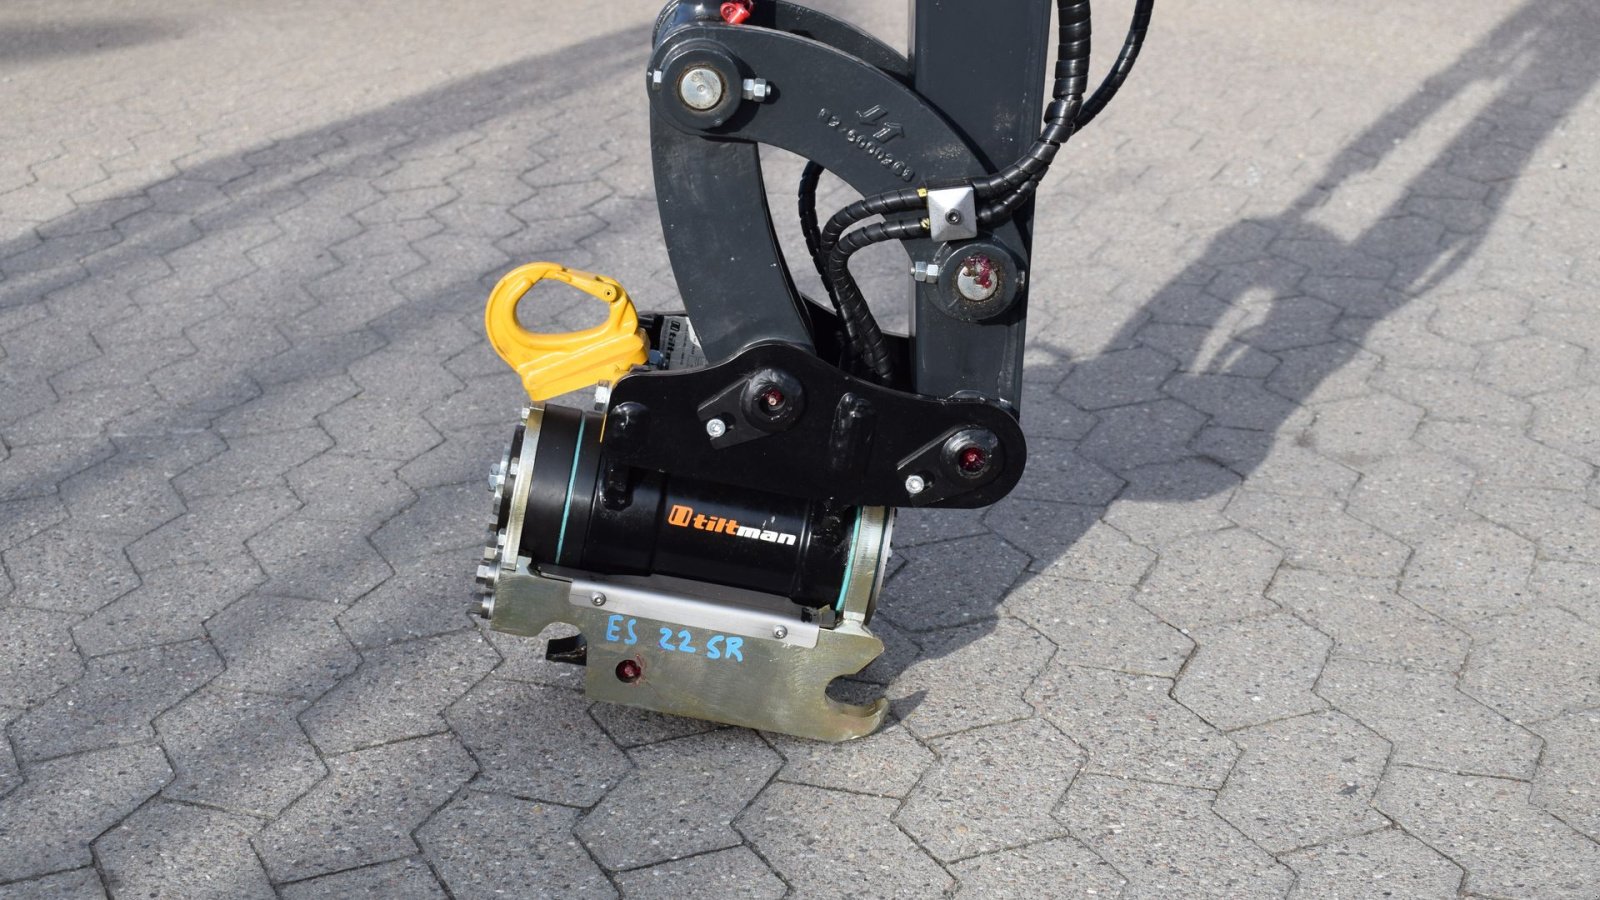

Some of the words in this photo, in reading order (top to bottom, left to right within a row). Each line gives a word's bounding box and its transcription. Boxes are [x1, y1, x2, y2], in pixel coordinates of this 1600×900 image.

[693, 513, 797, 546] tiltman
[606, 614, 638, 645] ES
[659, 627, 696, 653] 22
[706, 635, 744, 662] SR
